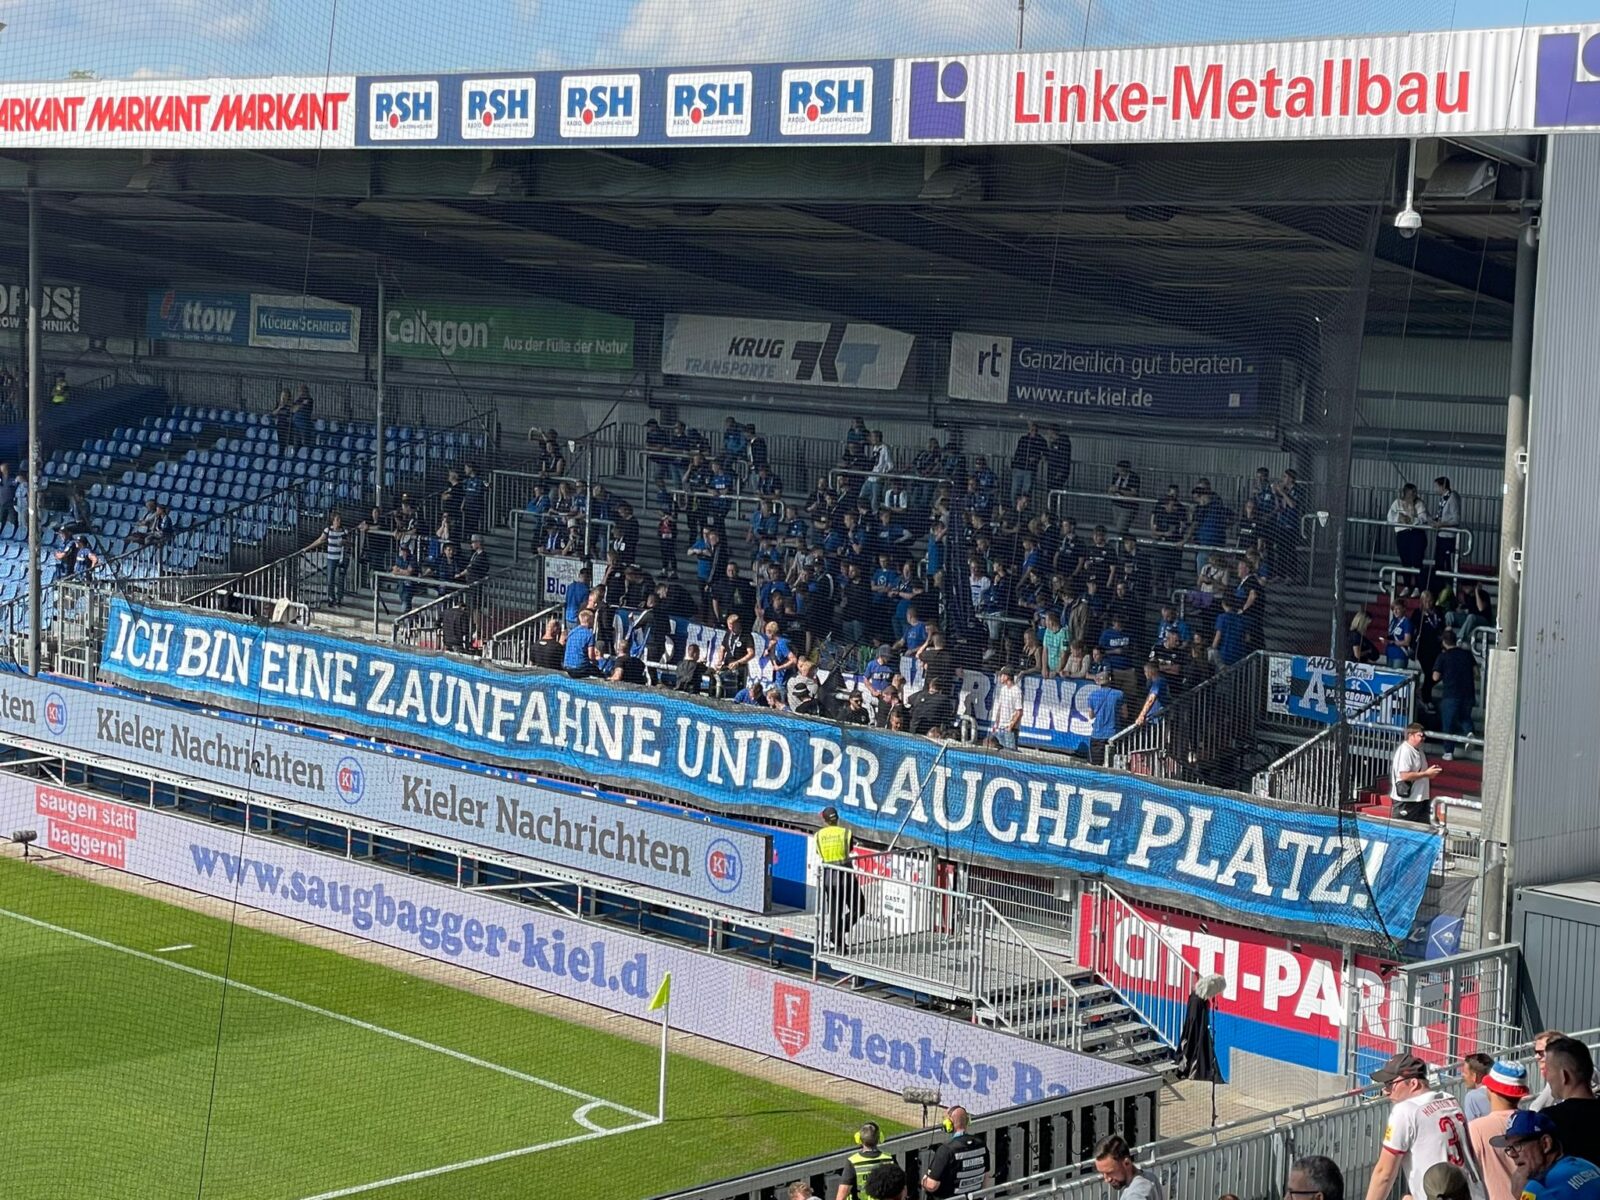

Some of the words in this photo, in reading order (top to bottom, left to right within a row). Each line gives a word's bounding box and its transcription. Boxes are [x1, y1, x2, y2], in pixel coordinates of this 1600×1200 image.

[376, 91, 432, 122] RSH
[468, 89, 529, 120] RSH
[567, 85, 633, 118] RSH
[674, 83, 744, 117] RSH
[789, 79, 865, 115] RSH
[1014, 58, 1471, 124] Linke-Metallbau
[0, 97, 85, 132] ARKANT
[85, 95, 211, 132] MARKANT
[210, 93, 350, 132] MARKANT
[385, 309, 488, 355] Cellagon
[503, 335, 523, 351] Aus
[526, 336, 545, 352] der
[574, 339, 593, 354] der
[596, 340, 628, 355] Natur
[728, 337, 784, 358] KRUG
[685, 358, 777, 379] TRANSPORTE
[977, 343, 1002, 377] rt
[1018, 347, 1124, 374] Ganzheitlich
[1131, 352, 1163, 380] gut
[1016, 384, 1152, 407] www.rut-kiel.de
[547, 577, 566, 595] Blo
[1308, 657, 1356, 674] AHDN
[97, 707, 165, 754] Kieler
[171, 723, 325, 791] Nachrichten
[110, 613, 174, 672] ICH
[176, 628, 253, 686] BIN
[260, 641, 358, 705] EINE
[366, 660, 662, 767] ZAUNFAHNE
[676, 717, 792, 791] UND
[806, 737, 1122, 856] BRAUCHE
[1126, 800, 1388, 909] PLATZ!
[339, 767, 360, 794] KN
[40, 792, 97, 822] saugen
[102, 808, 135, 832] statt
[402, 775, 489, 828] Kieler
[496, 795, 691, 877] Nachrichten
[51, 822, 123, 860] baggern!
[710, 850, 736, 881] KN
[189, 844, 649, 999] www.saugbagger-kiel.d
[1113, 917, 1431, 1048] CITTI-PARK
[822, 1010, 998, 1096] Flenker
